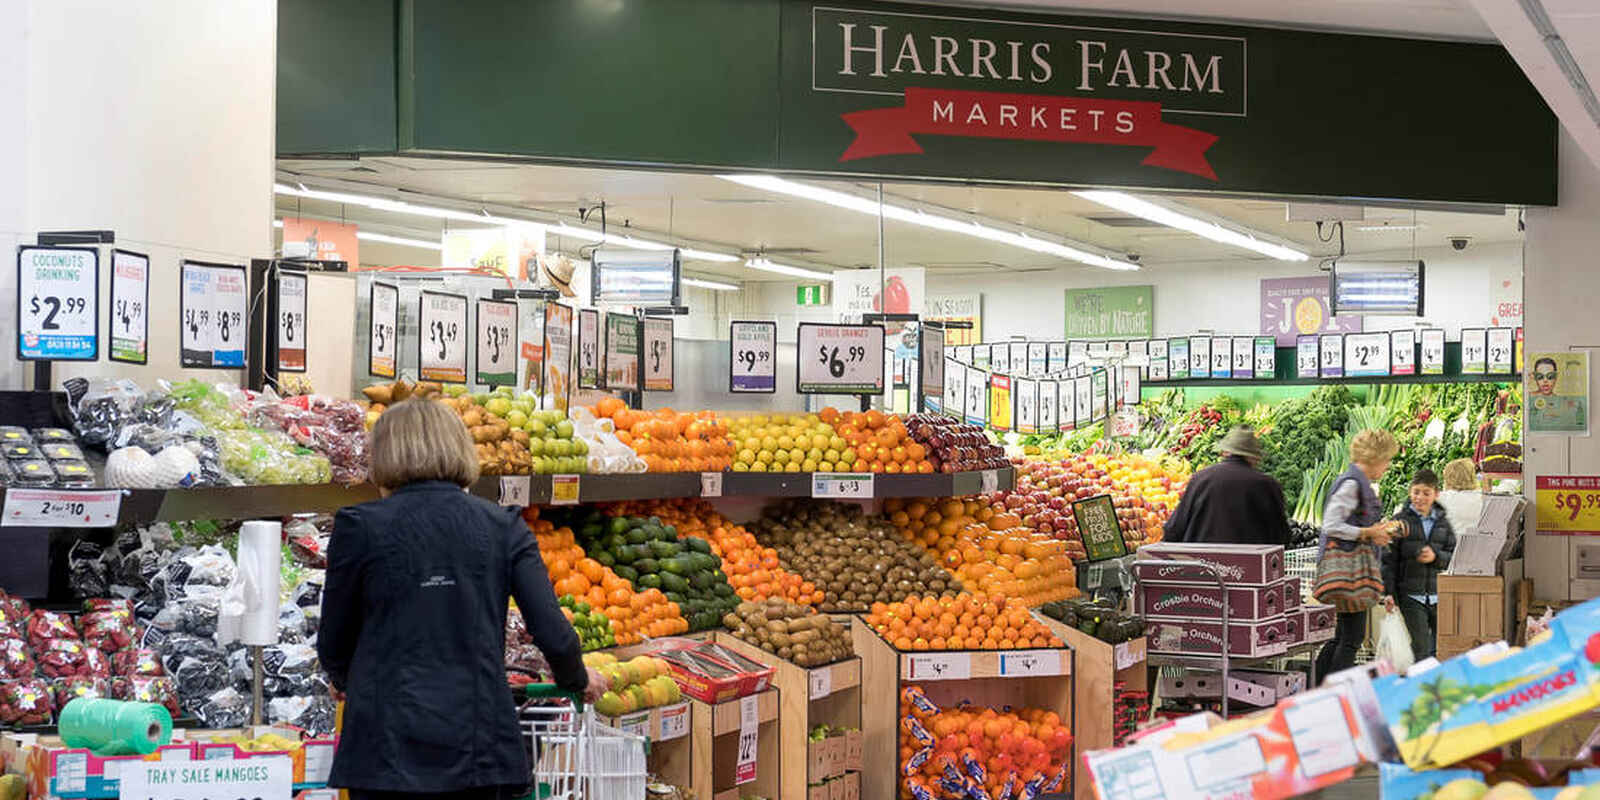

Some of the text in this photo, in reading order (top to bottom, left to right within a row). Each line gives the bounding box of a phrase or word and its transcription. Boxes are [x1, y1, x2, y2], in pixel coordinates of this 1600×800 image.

[838, 22, 1225, 94] HARRIS FARM
[932, 101, 1135, 134] MARKETS
[32, 254, 85, 268] COCONUTS
[35, 268, 80, 282] DRINKING
[30, 295, 86, 330] $2.99
[738, 350, 770, 372] $9.99
[819, 344, 865, 378] $6.99
[41, 502, 51, 514] 2
[65, 502, 85, 516] $10
[1089, 521, 1110, 534] FOR
[147, 766, 269, 785] TRAY SALE MANGOES
